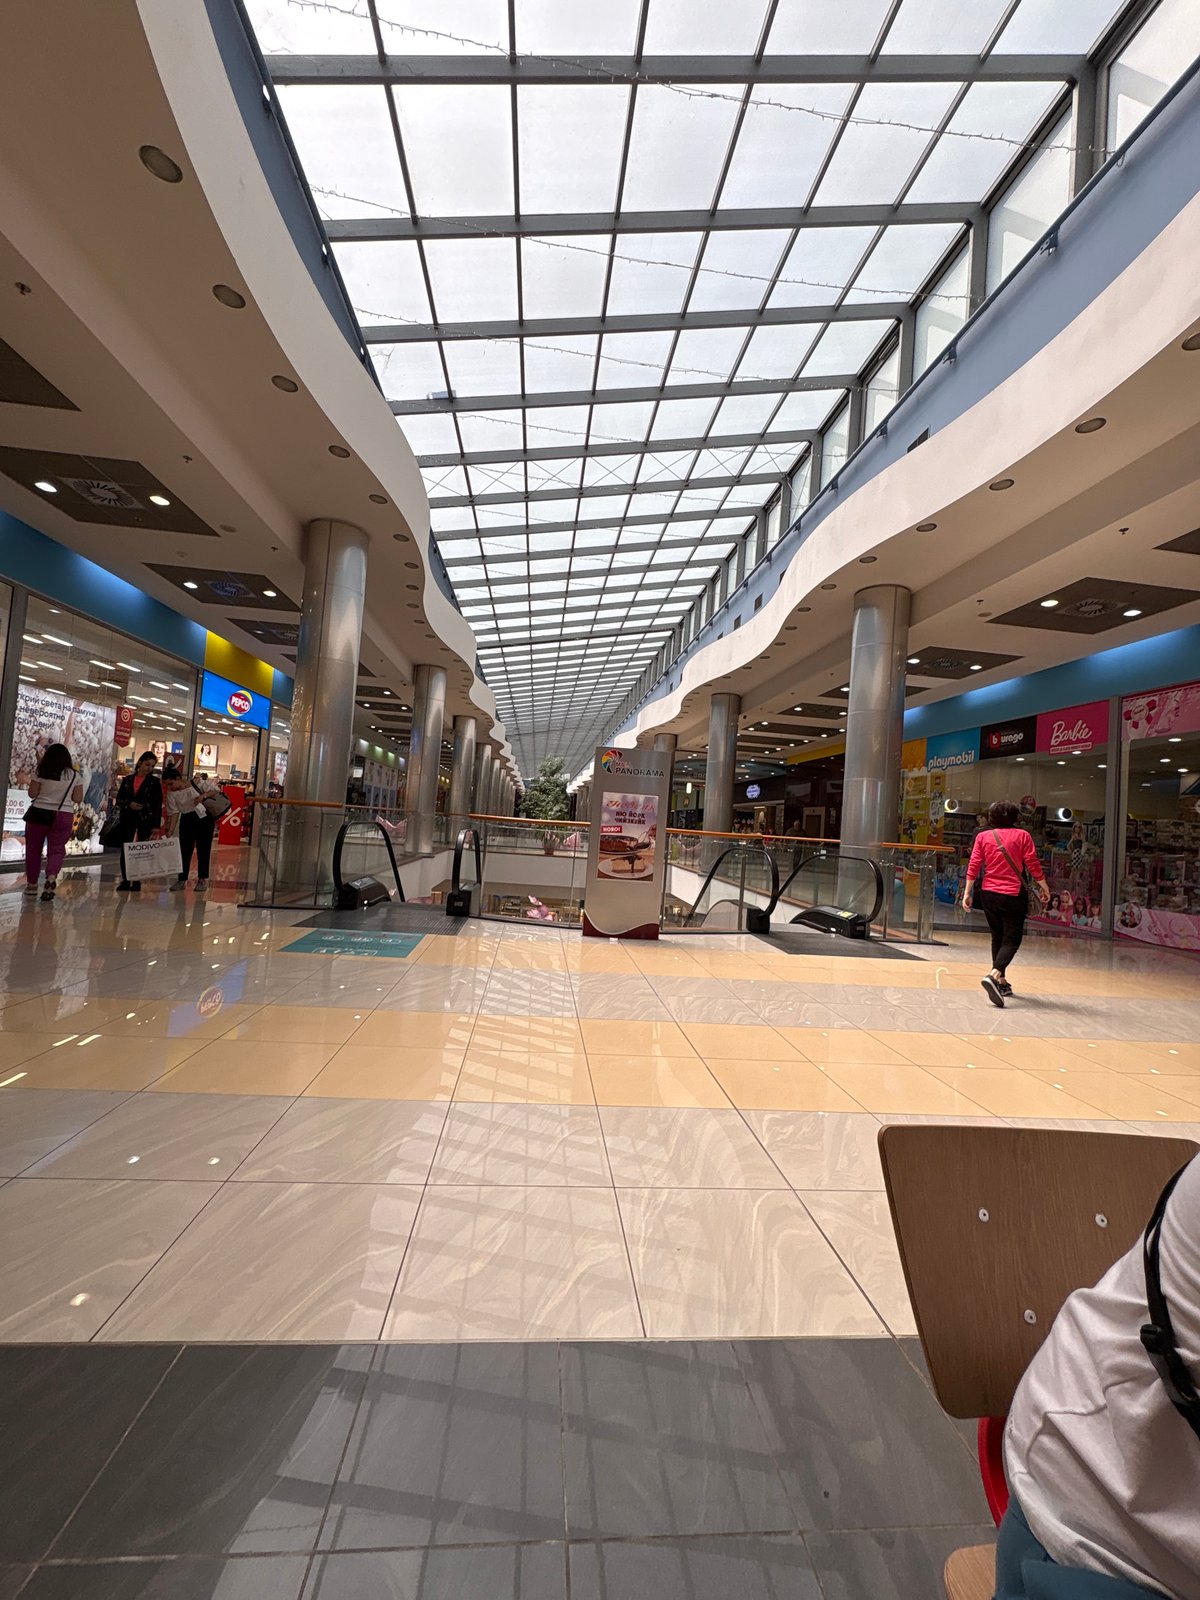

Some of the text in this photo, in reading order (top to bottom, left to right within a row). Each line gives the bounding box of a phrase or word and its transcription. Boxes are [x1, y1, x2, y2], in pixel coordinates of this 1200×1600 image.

[41, 699, 62, 710] света
[62, 704, 72, 712] на
[72, 706, 97, 718] памука
[231, 695, 249, 710] PEPCO
[19, 705, 66, 722] невероятно
[992, 732, 1024, 744] burago
[1051, 720, 1093, 746] Barbie
[928, 750, 974, 772] playmobil
[615, 767, 664, 777] PANORAMA
[614, 817, 646, 825] ЧИЙЗКЕЙК
[628, 810, 646, 819] ЙОРК
